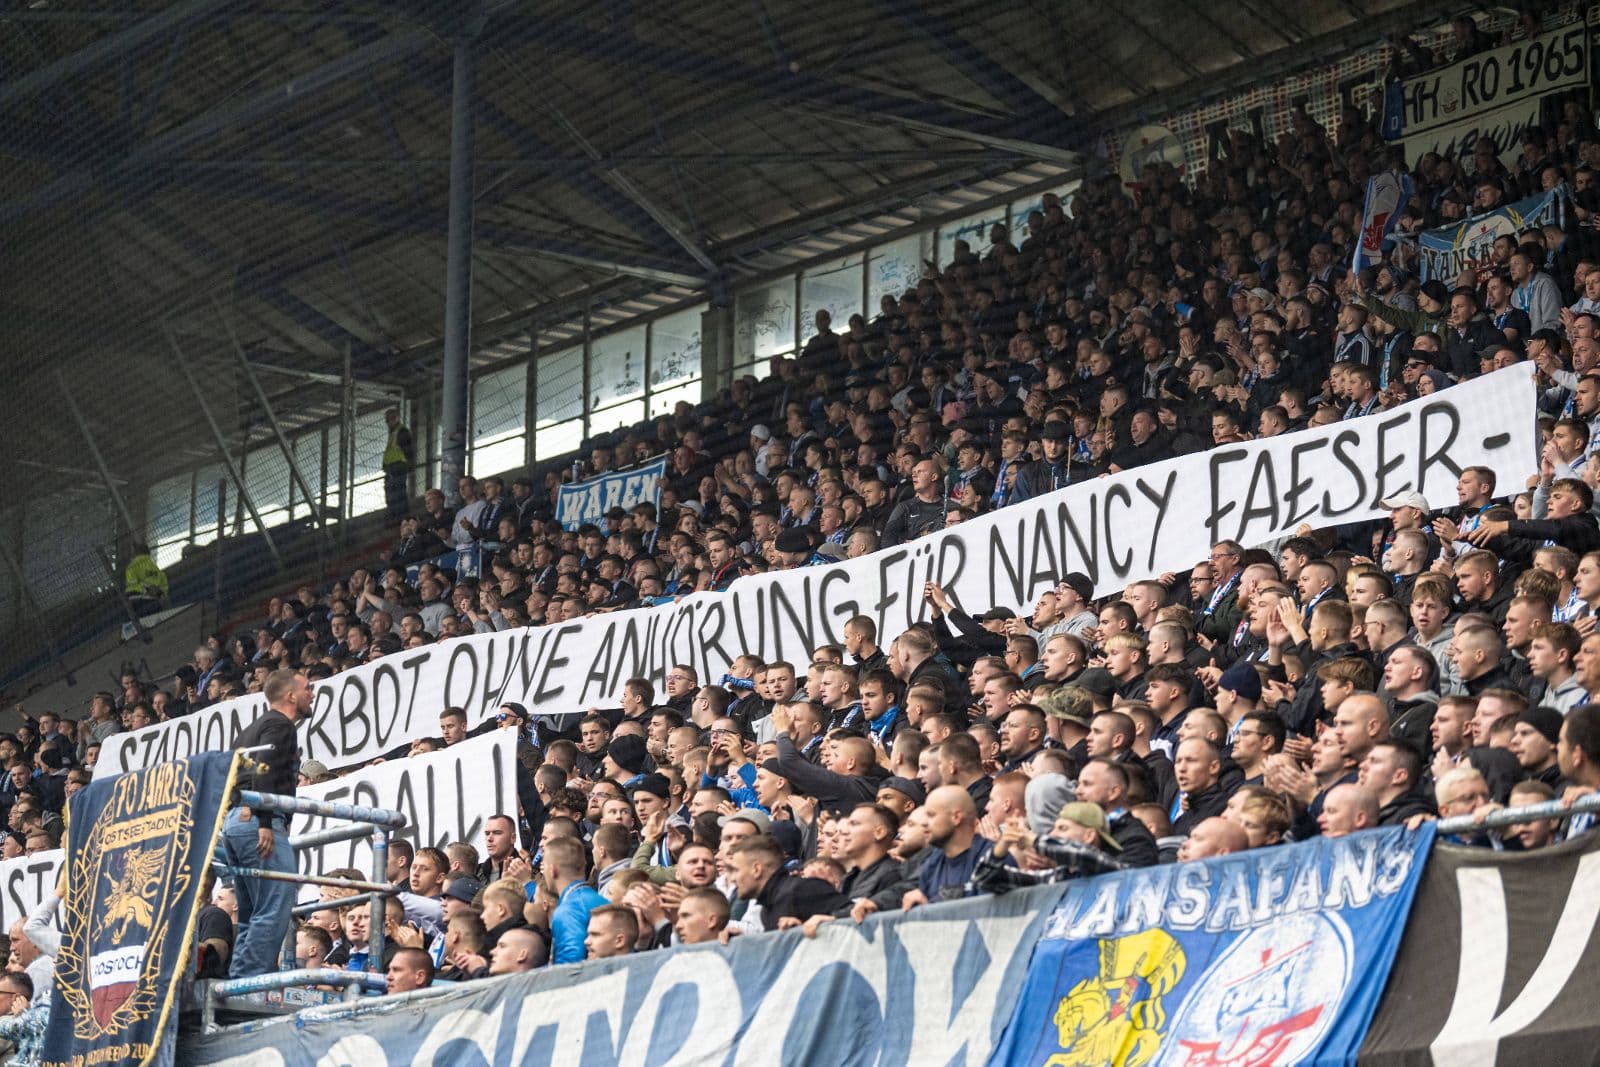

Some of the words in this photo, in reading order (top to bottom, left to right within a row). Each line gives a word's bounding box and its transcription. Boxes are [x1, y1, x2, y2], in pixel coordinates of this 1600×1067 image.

[1402, 77, 1441, 129] HH
[1461, 56, 1500, 110] RO
[1507, 29, 1584, 95] 1965
[562, 472, 659, 523] WAREN
[443, 623, 584, 718] OHNE
[579, 568, 860, 705] ANHÖRUNG
[875, 533, 966, 646] FÜR
[989, 469, 1178, 608] NANCY
[137, 760, 183, 812] JAHRE
[293, 743, 504, 877] BERALL!
[1044, 835, 1415, 941] HANSAFANS
[195, 910, 1040, 1067] TOCK
